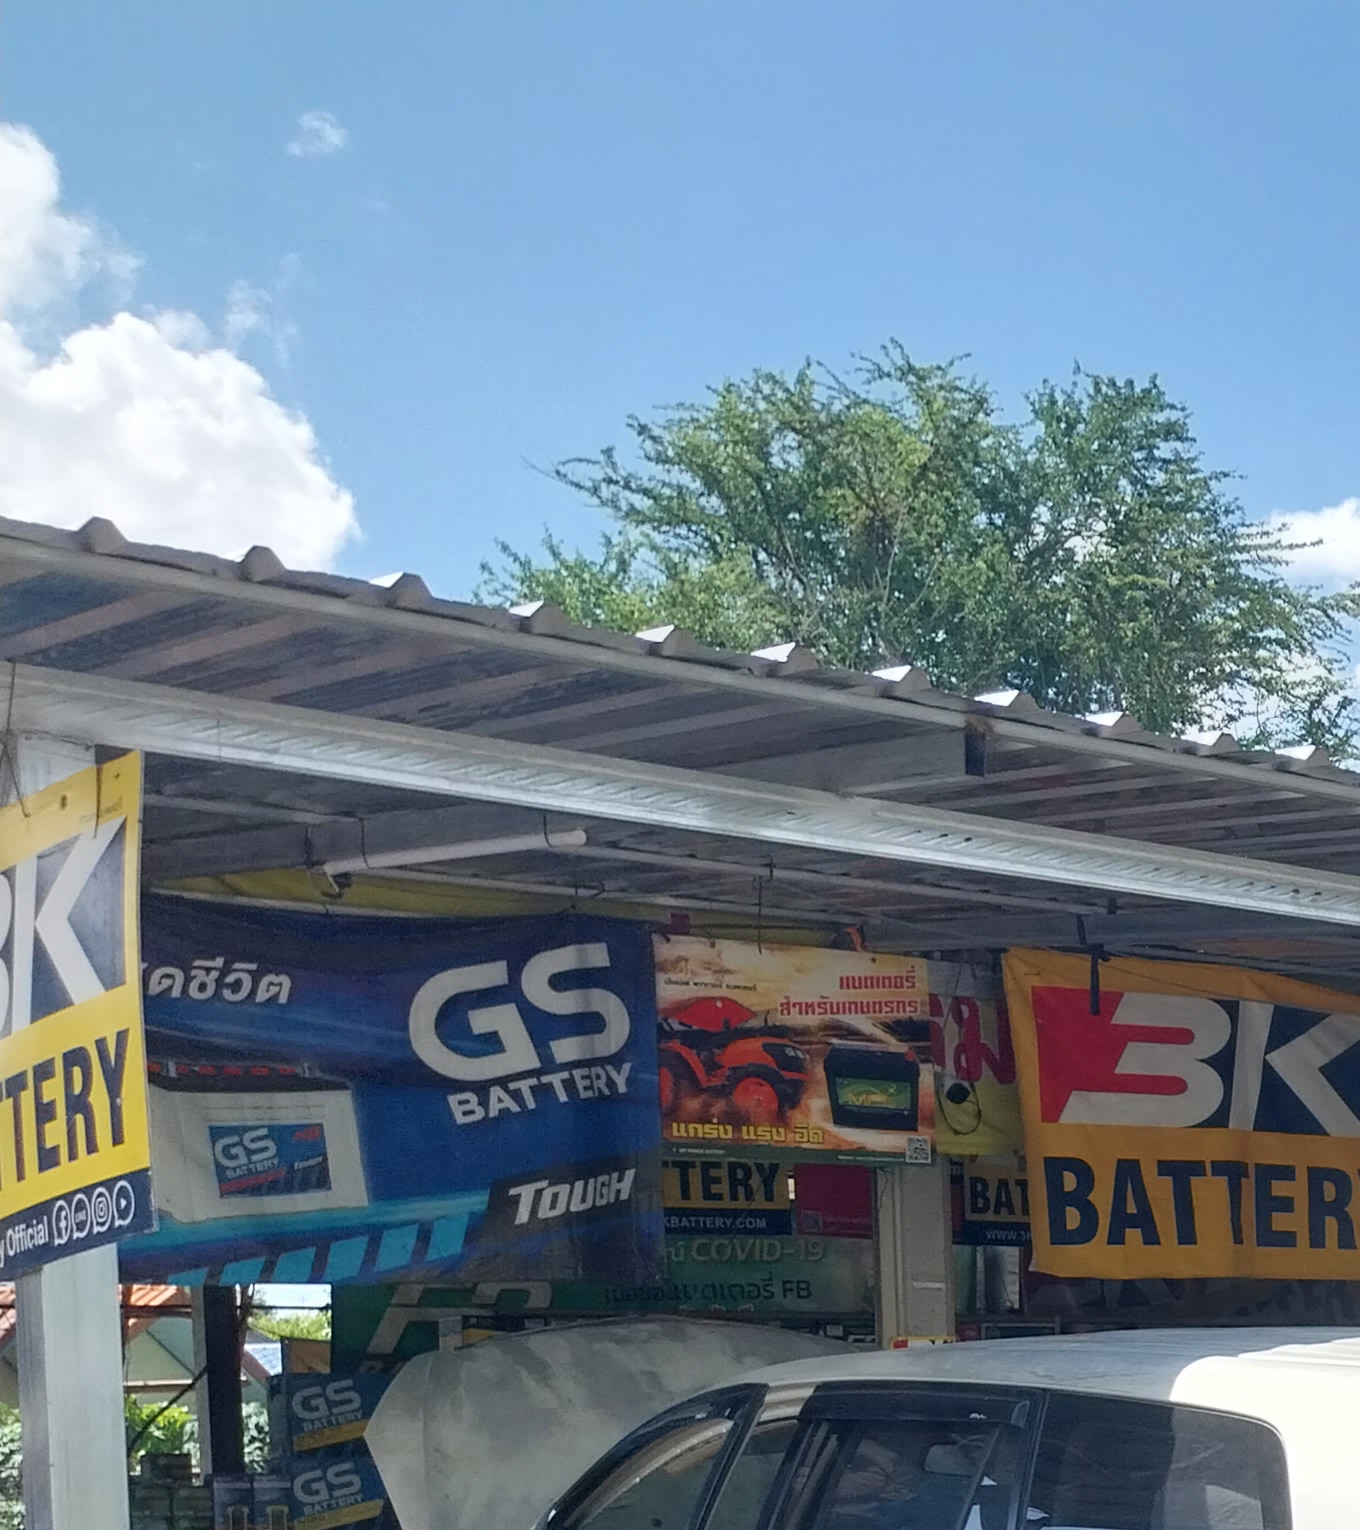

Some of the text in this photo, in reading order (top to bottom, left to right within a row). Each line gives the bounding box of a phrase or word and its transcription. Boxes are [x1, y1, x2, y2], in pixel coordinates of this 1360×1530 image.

[0, 814, 127, 1040] K
[141, 957, 292, 1004] ดชีวิต
[839, 964, 917, 991] แบตเตอรี่
[408, 942, 631, 1081] GS
[778, 995, 920, 1017] สำหรับเกษตรกร
[0, 1027, 130, 1190] TERY
[447, 1062, 632, 1126] BATTERY
[215, 1127, 278, 1168] GS
[671, 1117, 733, 1139] แกร่ง
[741, 1124, 788, 1142] แรง
[662, 1160, 780, 1202] TERY
[6, 1215, 48, 1256] Official
[691, 1238, 826, 1262] COVID-19
[782, 1280, 812, 1300] FB
[291, 1378, 362, 1420] GS
[293, 1461, 362, 1503] GS
